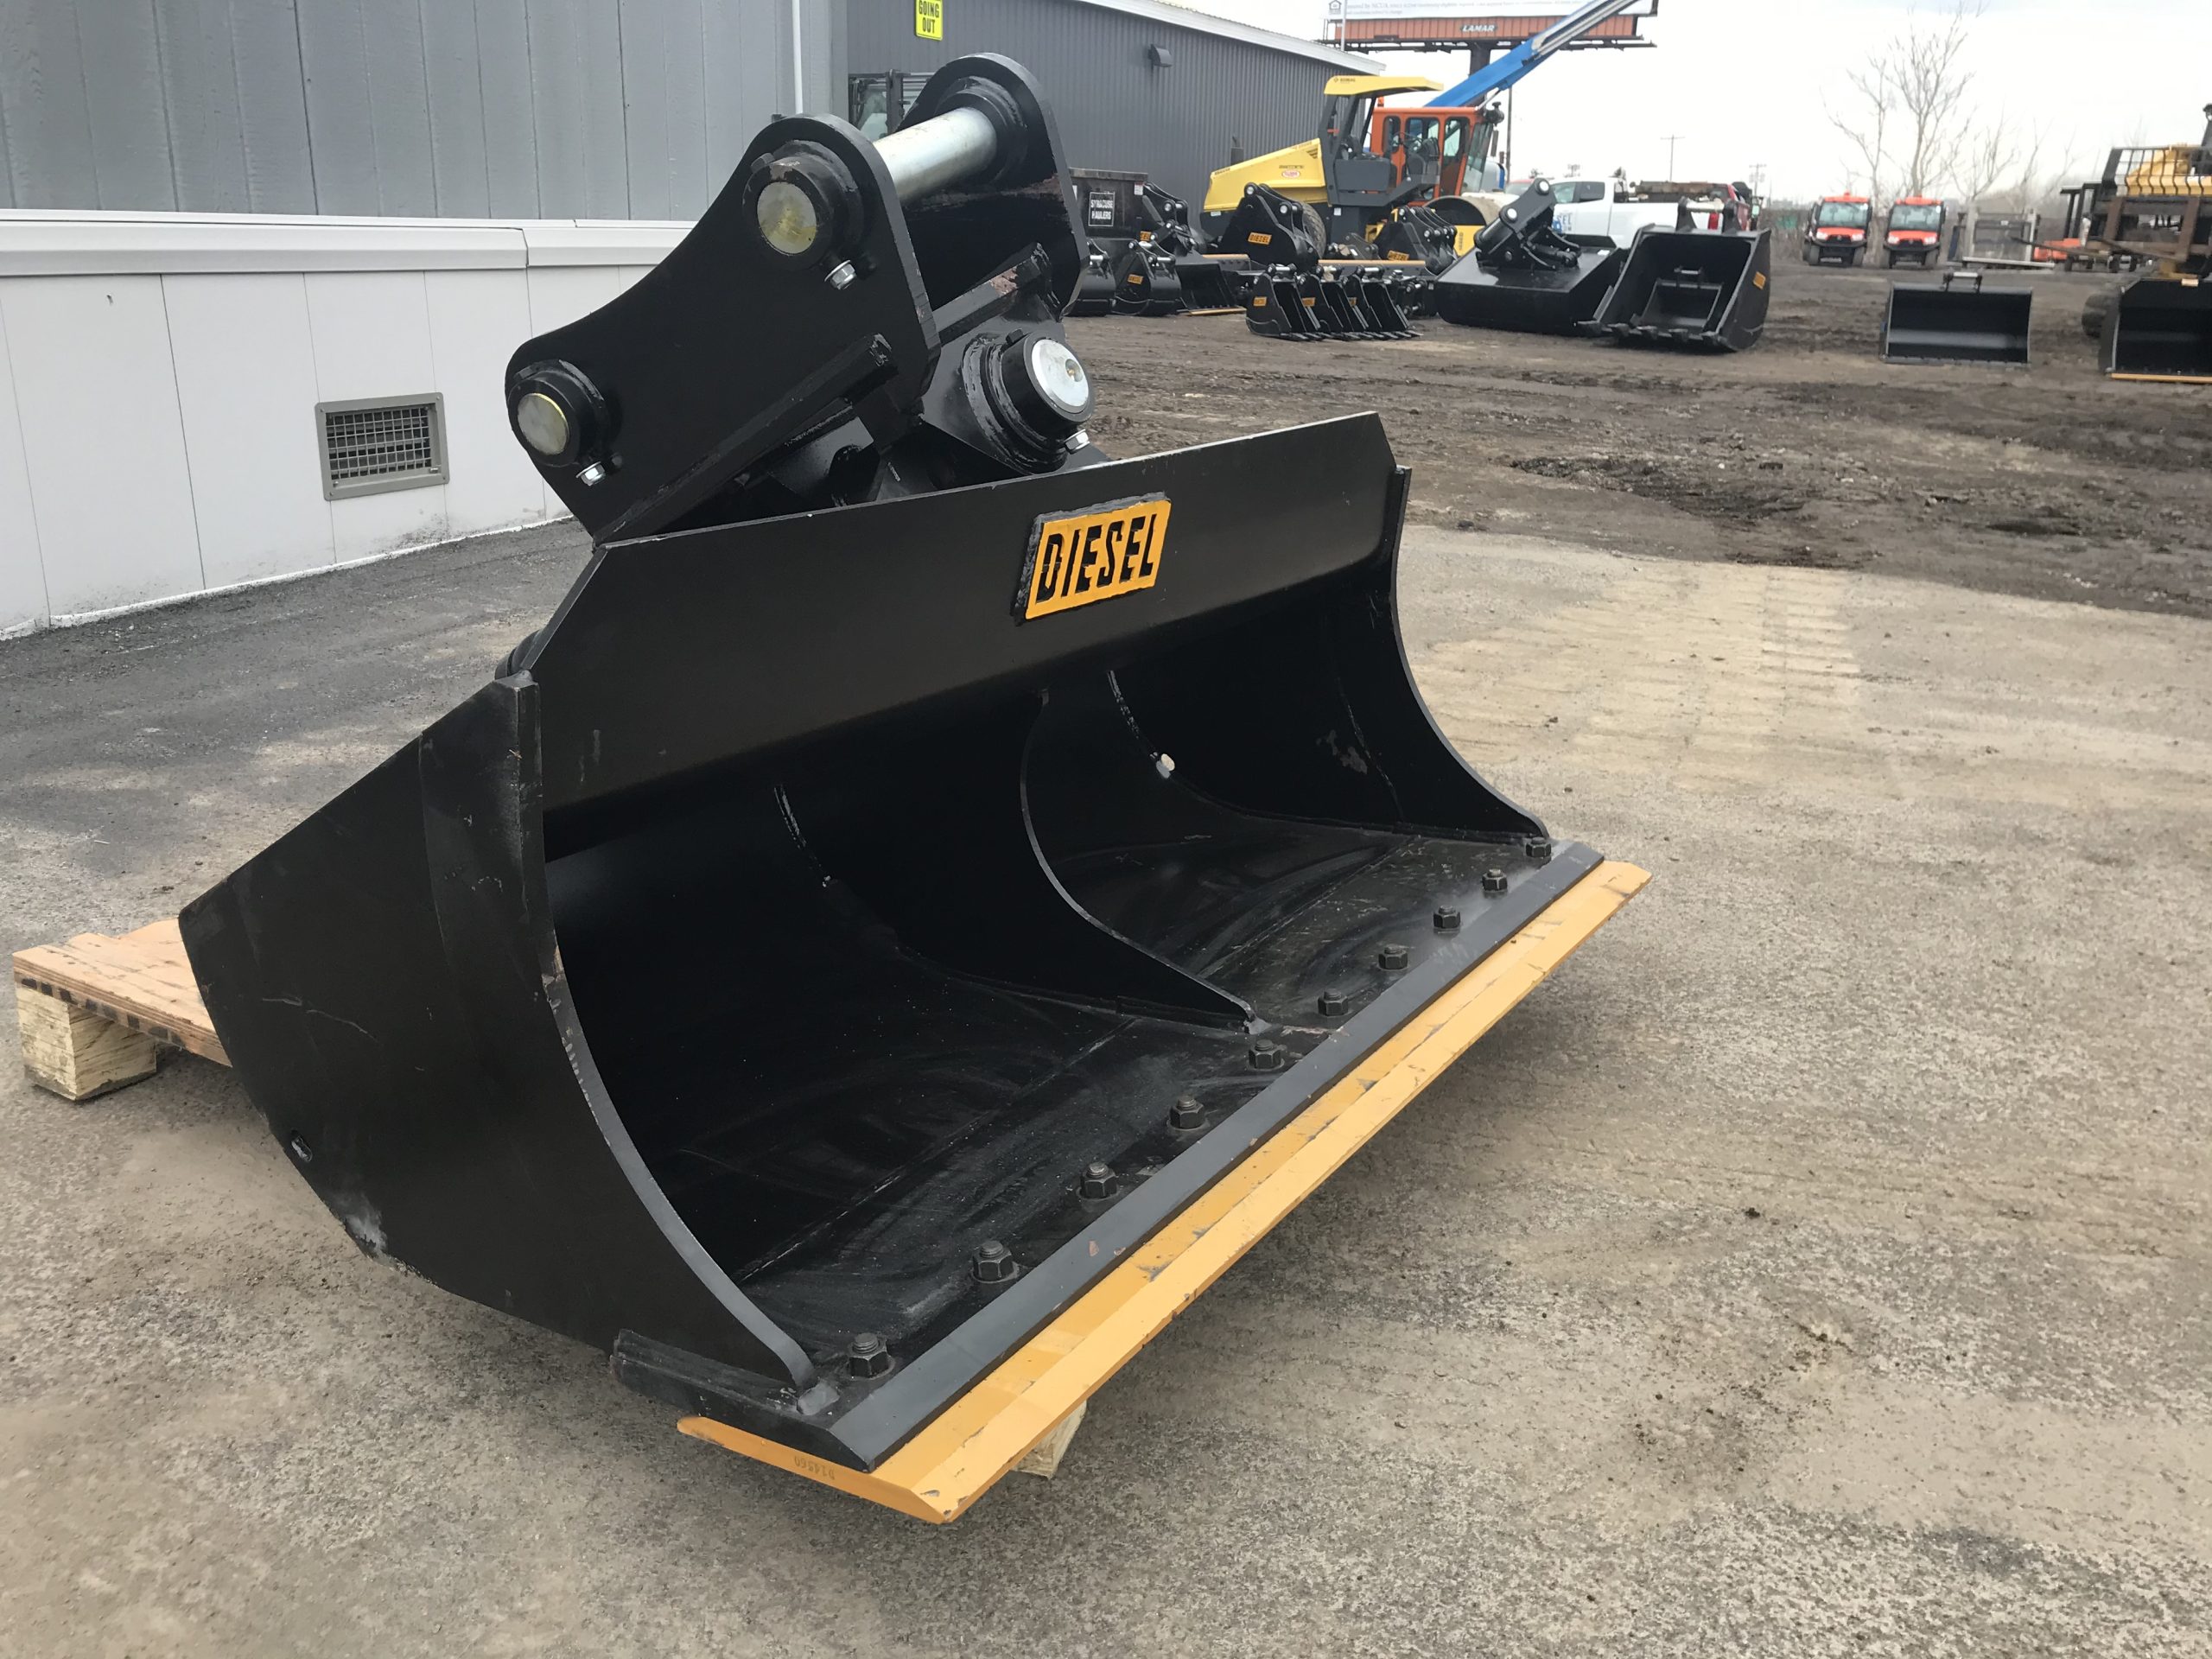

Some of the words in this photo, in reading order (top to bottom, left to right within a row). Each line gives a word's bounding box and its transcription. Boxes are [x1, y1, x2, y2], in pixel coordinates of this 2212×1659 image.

[918, 0, 939, 18] GOING
[922, 16, 935, 34] OUT
[1036, 513, 1158, 604] DIESEL
